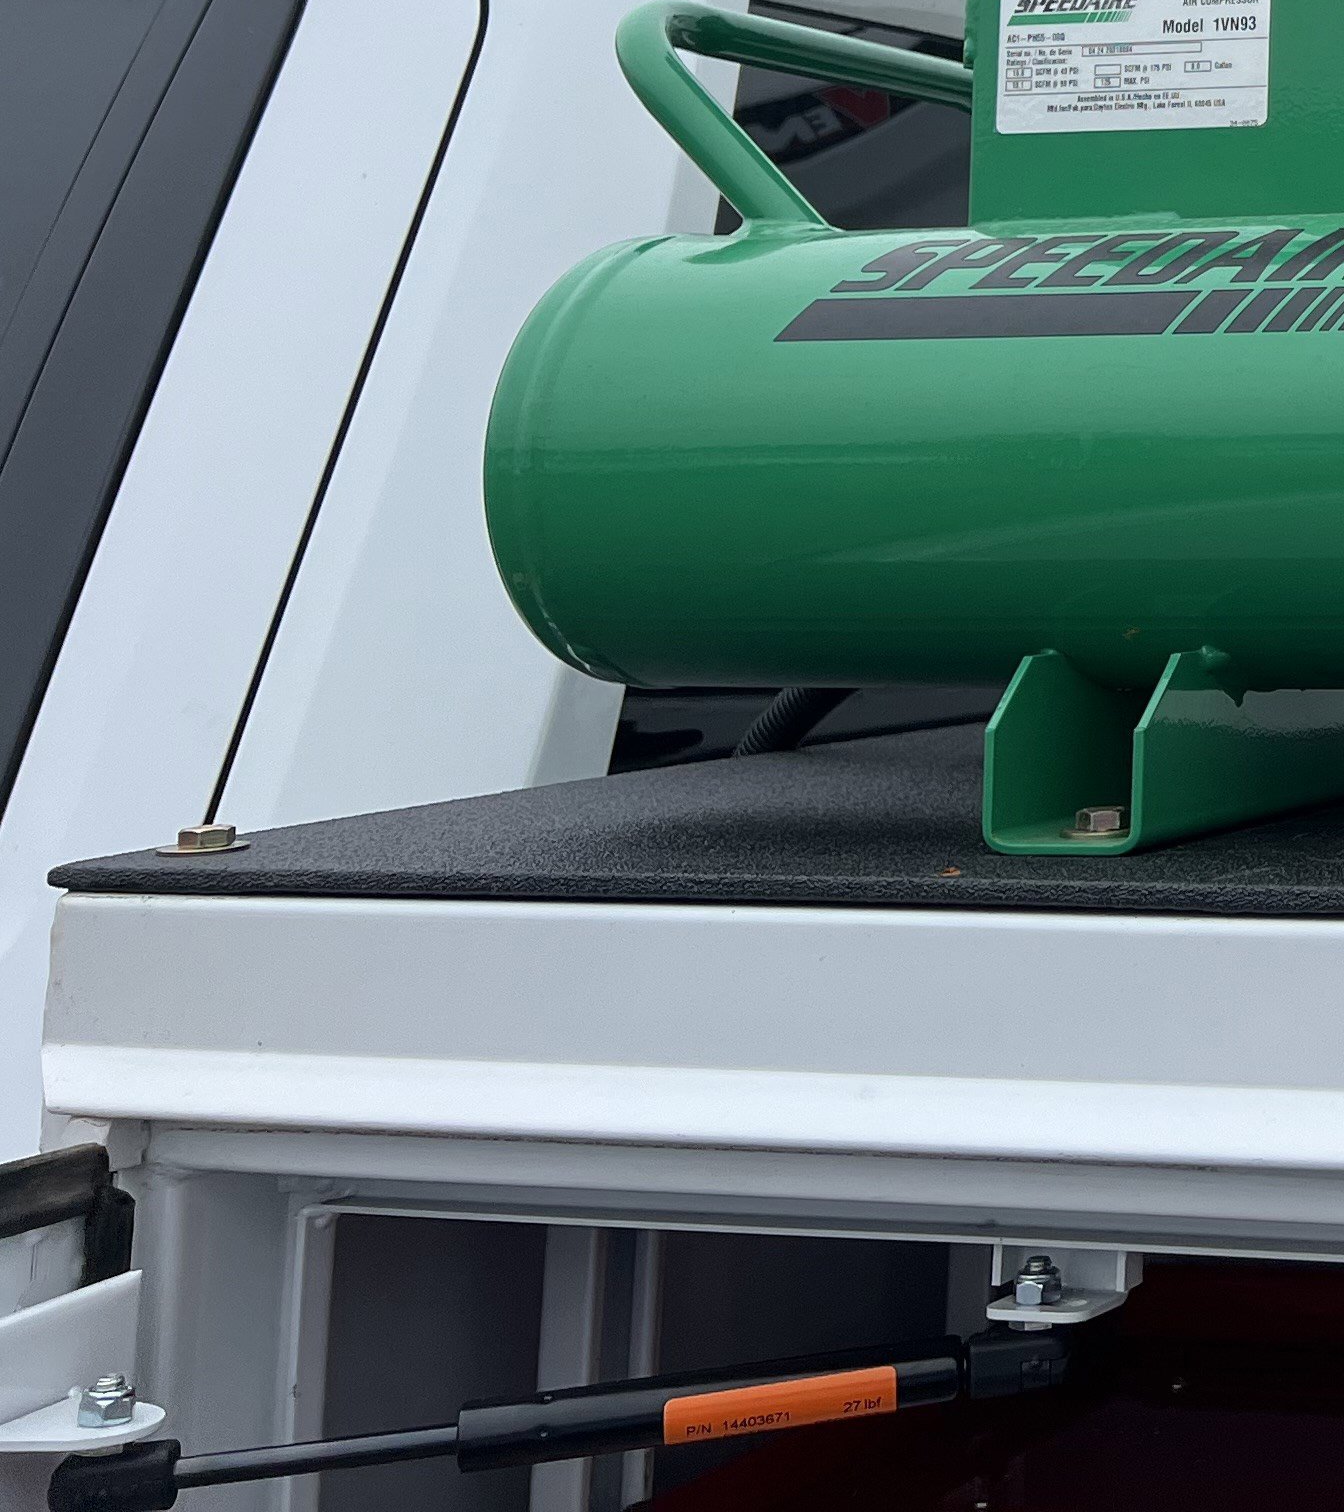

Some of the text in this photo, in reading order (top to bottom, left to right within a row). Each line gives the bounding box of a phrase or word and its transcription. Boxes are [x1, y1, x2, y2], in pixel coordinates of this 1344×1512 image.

[1163, 16, 1256, 33] Model 1VN93
[686, 1397, 882, 1437] P/N 14403671 27 lbf
